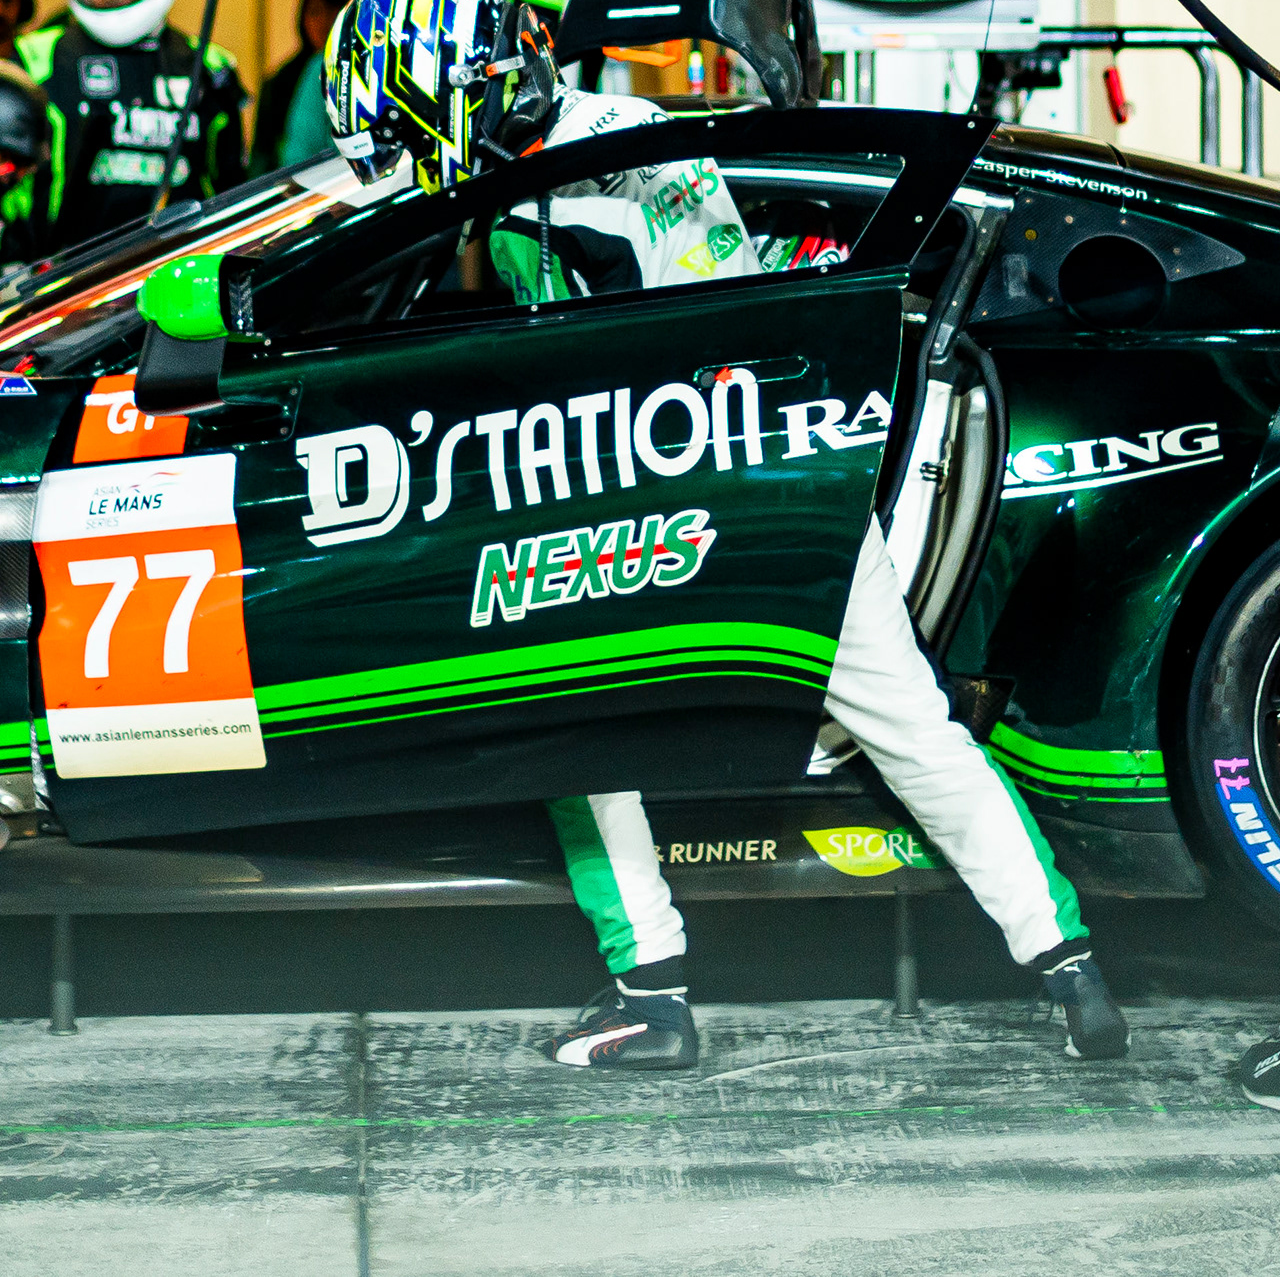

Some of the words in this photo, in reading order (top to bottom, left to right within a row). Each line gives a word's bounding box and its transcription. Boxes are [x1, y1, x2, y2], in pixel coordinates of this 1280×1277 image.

[640, 158, 719, 249] NEXUS
[295, 368, 764, 547] D'STATION
[93, 484, 122, 497] ASIAN
[89, 498, 109, 516] LE
[114, 493, 164, 512] MANS
[86, 516, 120, 530] SERIES
[470, 509, 718, 628] NEXUS
[66, 548, 216, 680] 77
[59, 722, 252, 744] www.asianlemansseries.com
[669, 839, 778, 864] RUNNER
